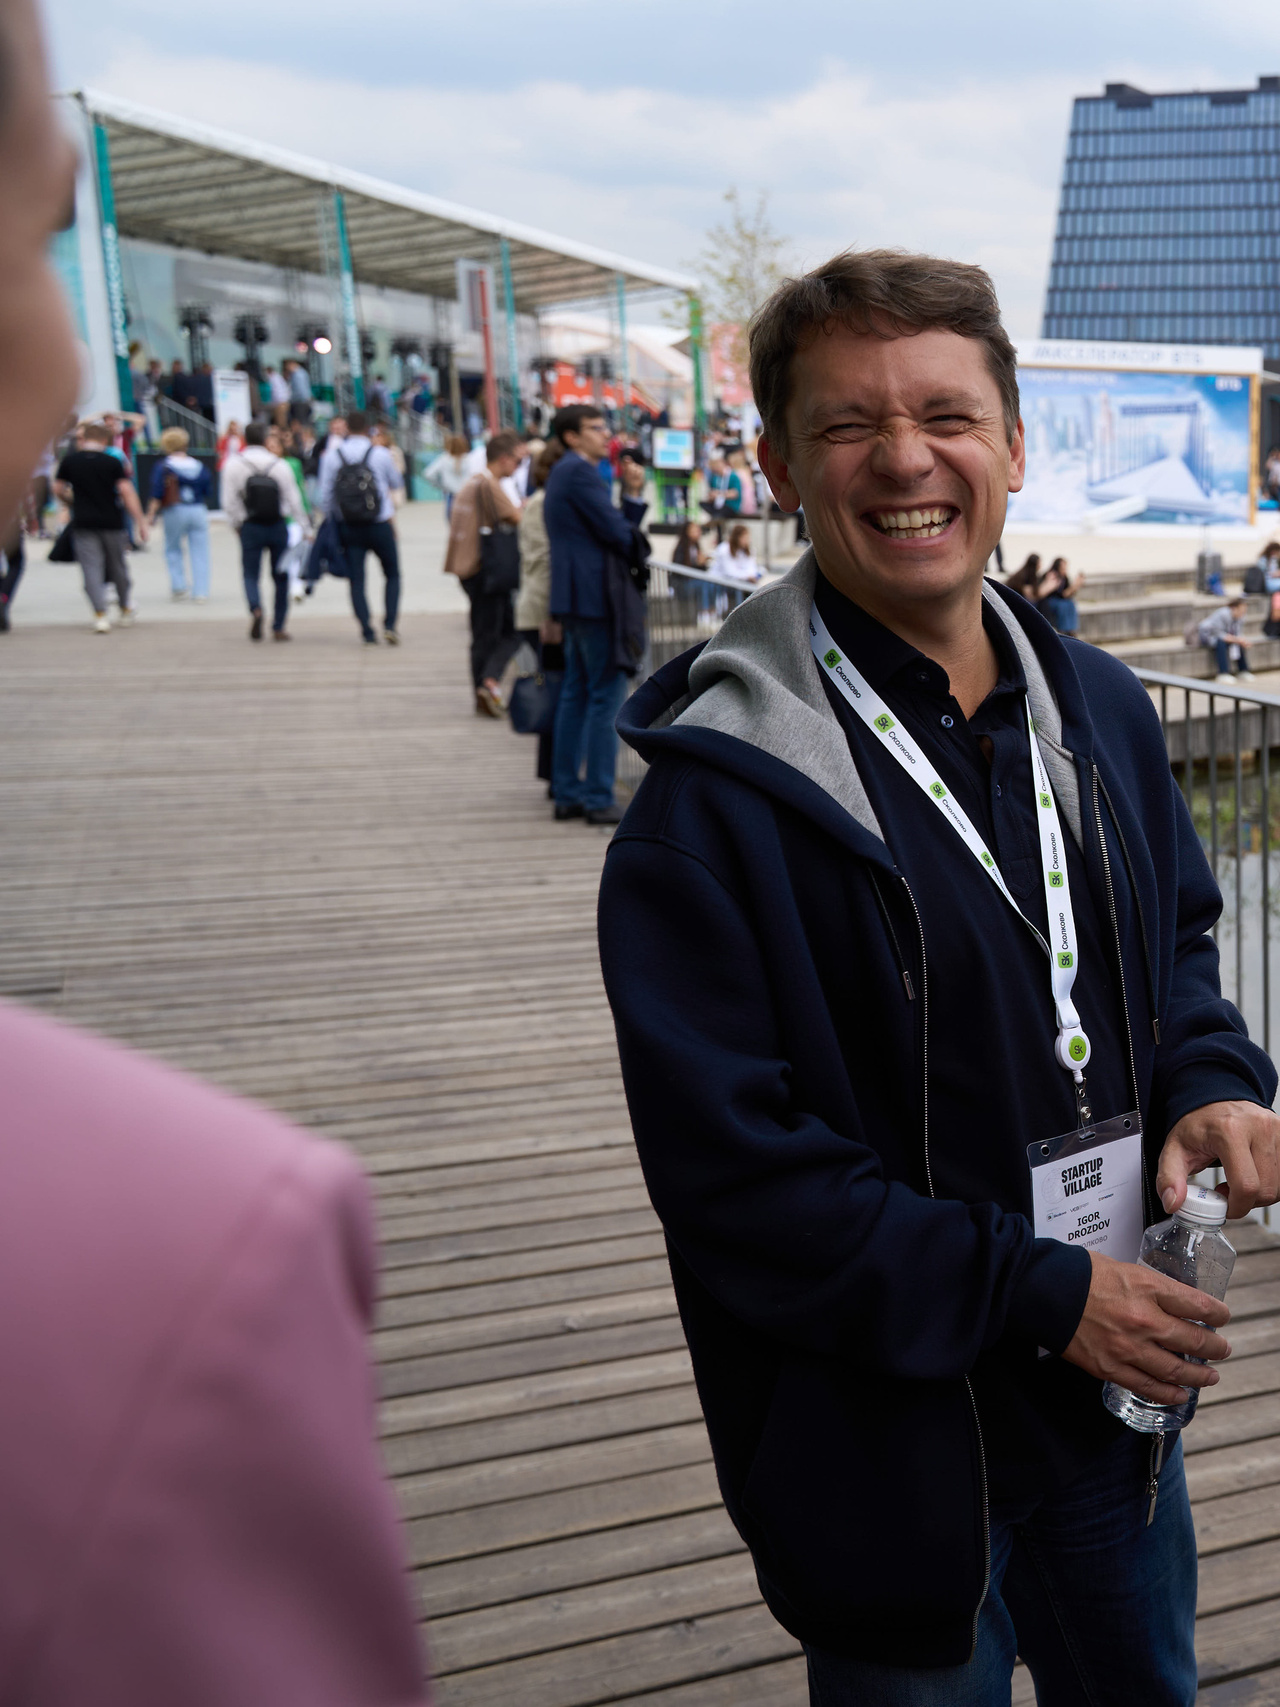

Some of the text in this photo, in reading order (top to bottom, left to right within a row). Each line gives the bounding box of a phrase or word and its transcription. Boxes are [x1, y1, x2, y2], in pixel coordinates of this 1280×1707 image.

[835, 665, 862, 699] Сколково
[888, 731, 916, 765] Сколково
[942, 799, 967, 833] Сколково
[1050, 832, 1060, 870] Сколково
[1058, 912, 1069, 950] Сколково
[1061, 1157, 1103, 1182] STARTUP
[1063, 1172, 1102, 1197] VILLAGE
[1068, 1218, 1110, 1241] DROZDOV
[1077, 1211, 1101, 1227] IGOR
